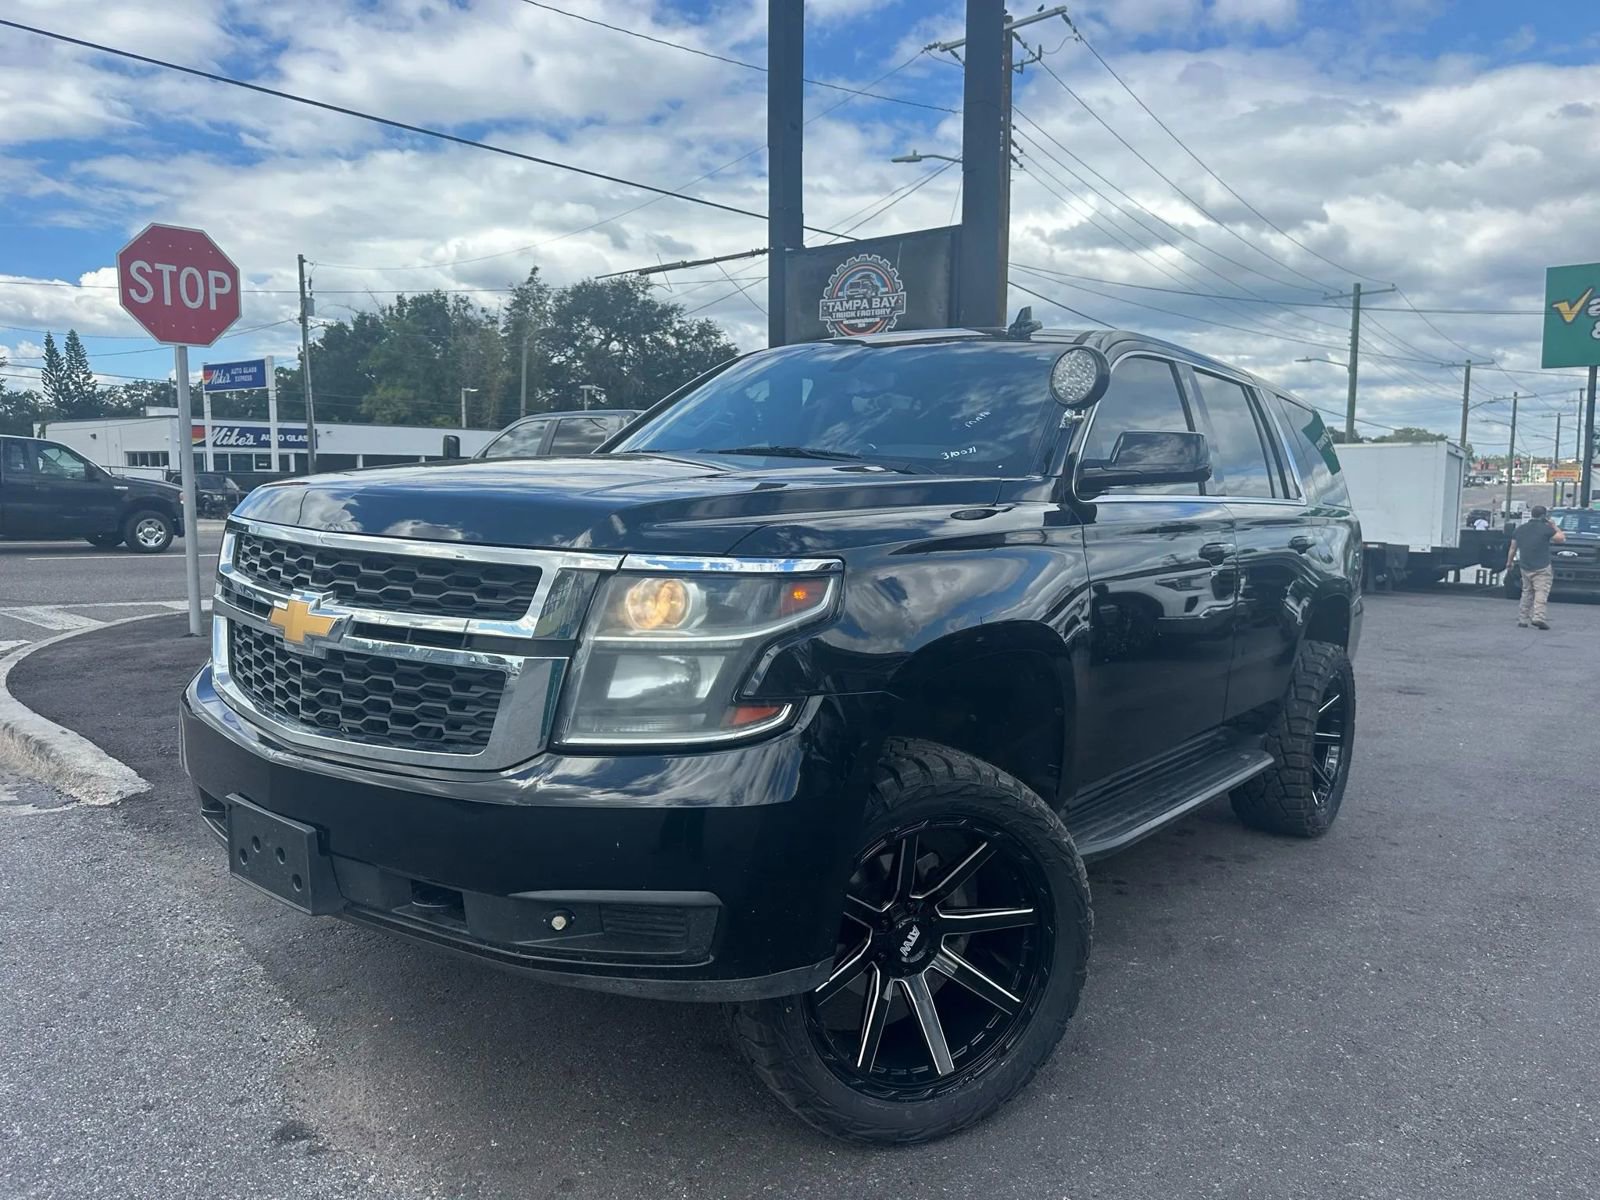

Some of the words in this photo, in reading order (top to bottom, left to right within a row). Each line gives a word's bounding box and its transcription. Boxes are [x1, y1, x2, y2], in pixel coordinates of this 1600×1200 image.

[128, 260, 232, 311] STOP
[827, 299, 869, 312] TAMPA
[872, 296, 898, 309] BAY
[832, 310, 856, 319] TRUCK
[857, 308, 891, 317] FACTORY
[210, 427, 257, 446] Mike's
[286, 434, 309, 442] GLAS
[900, 924, 920, 957] ATW
